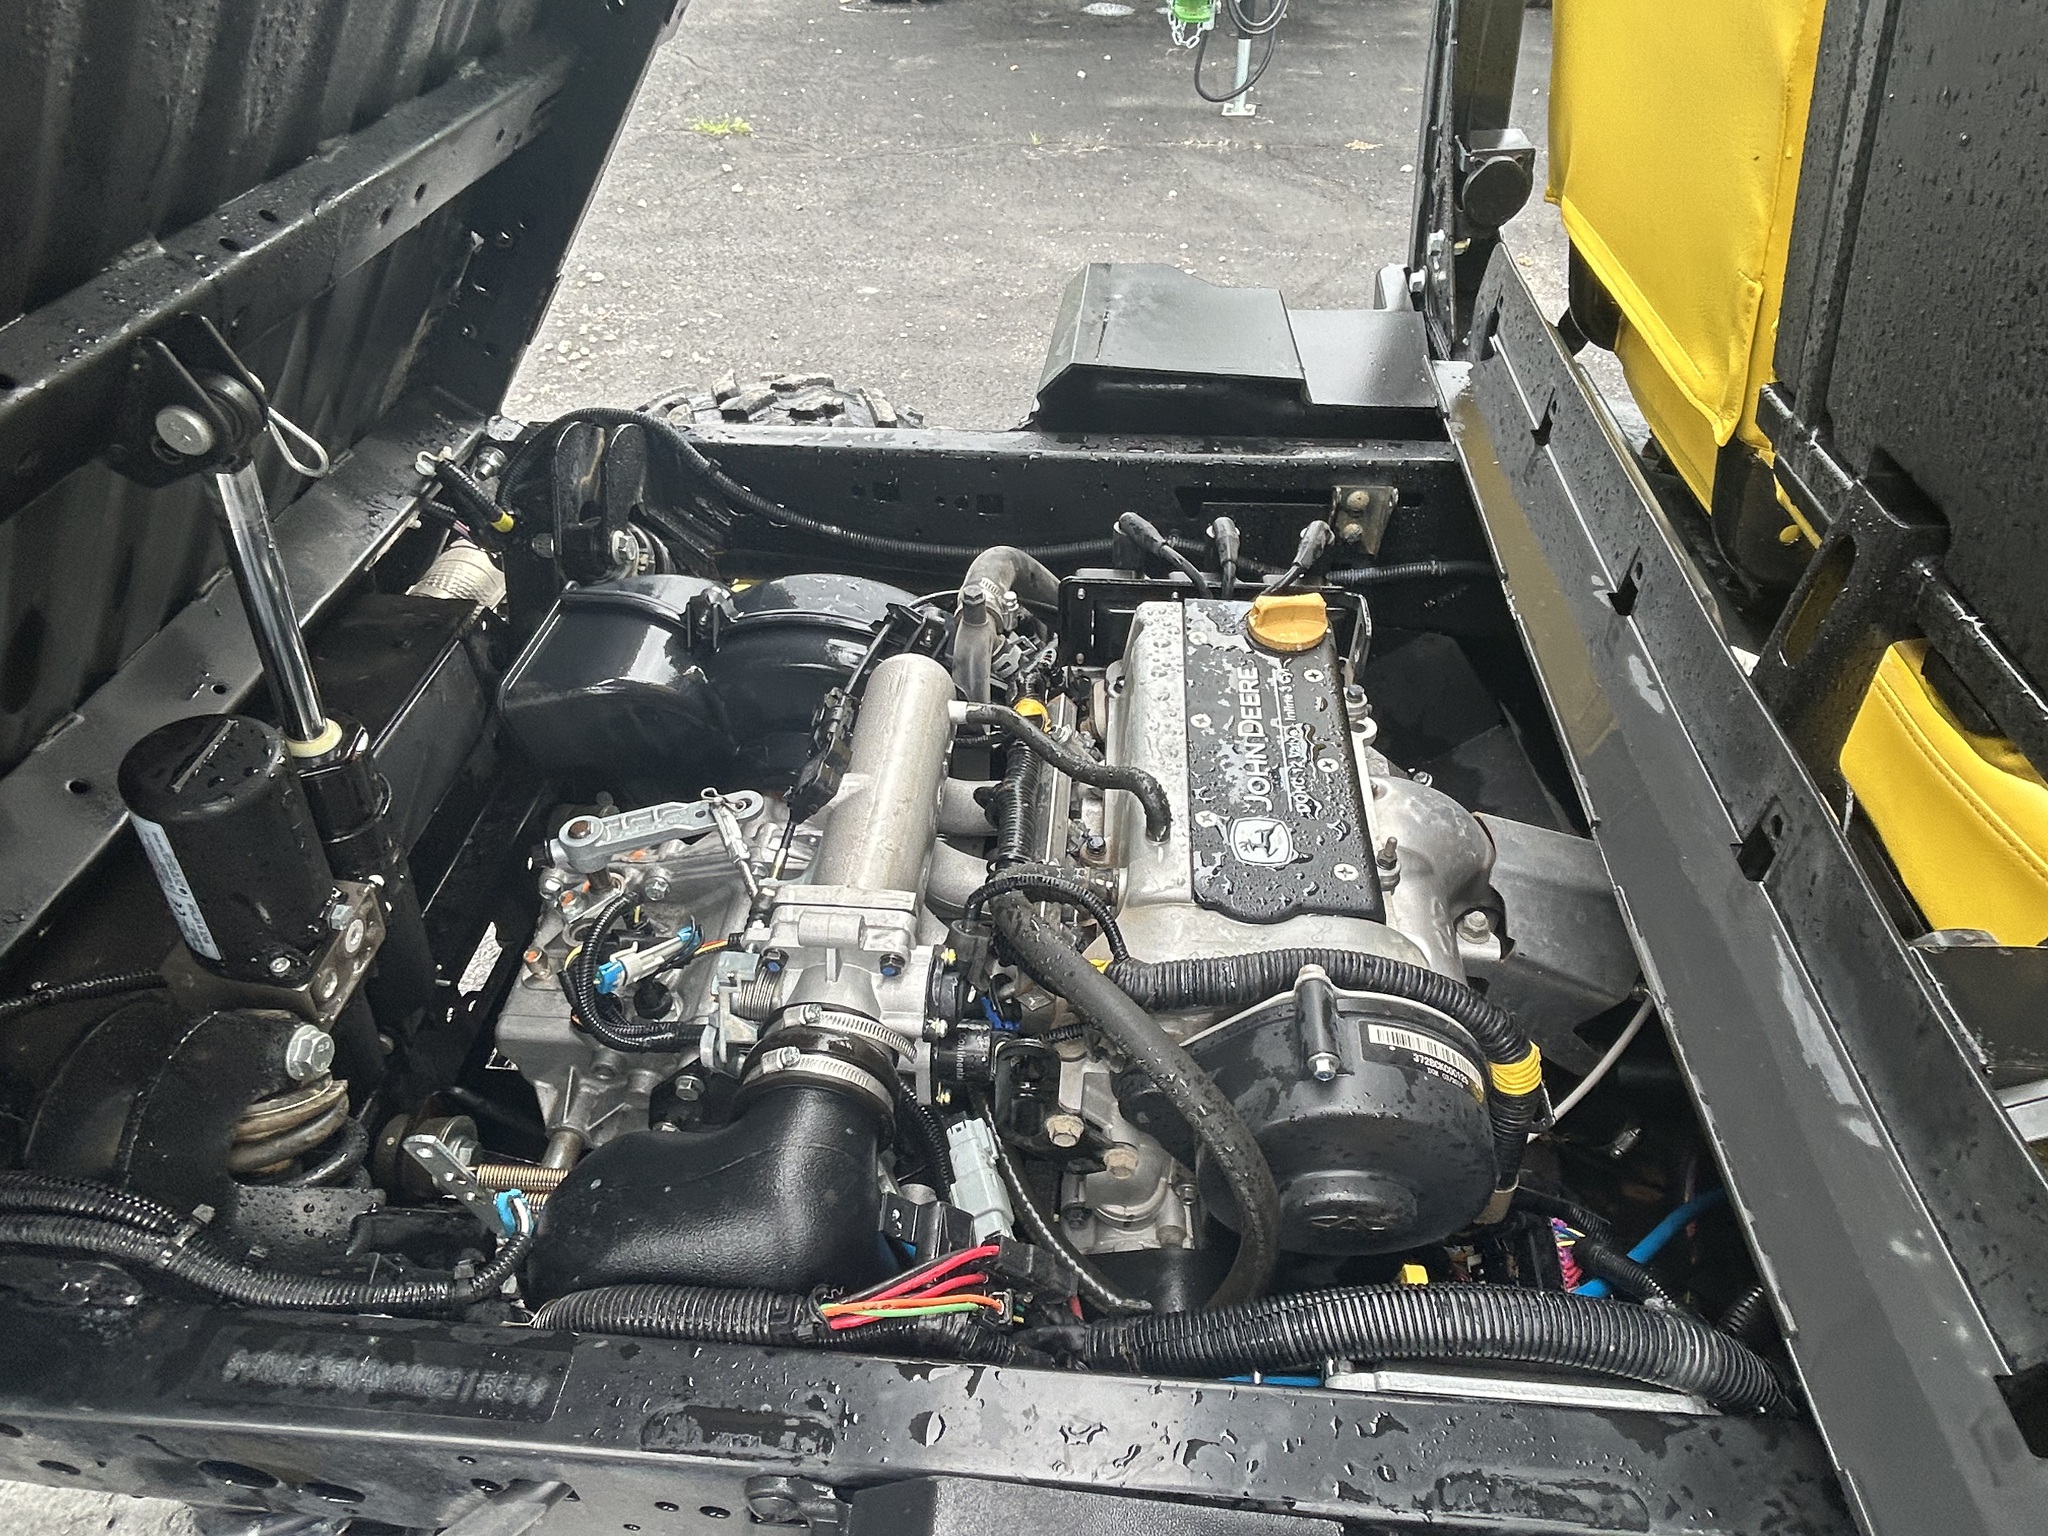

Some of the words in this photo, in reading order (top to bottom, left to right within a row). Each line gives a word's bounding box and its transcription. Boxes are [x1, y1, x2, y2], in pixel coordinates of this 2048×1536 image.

[1237, 666, 1265, 737] DEERE
[1279, 685, 1293, 693] 3
[1283, 693, 1297, 721] Inline
[1242, 740, 1272, 812] JOHN
[1289, 776, 1311, 814] DOHC
